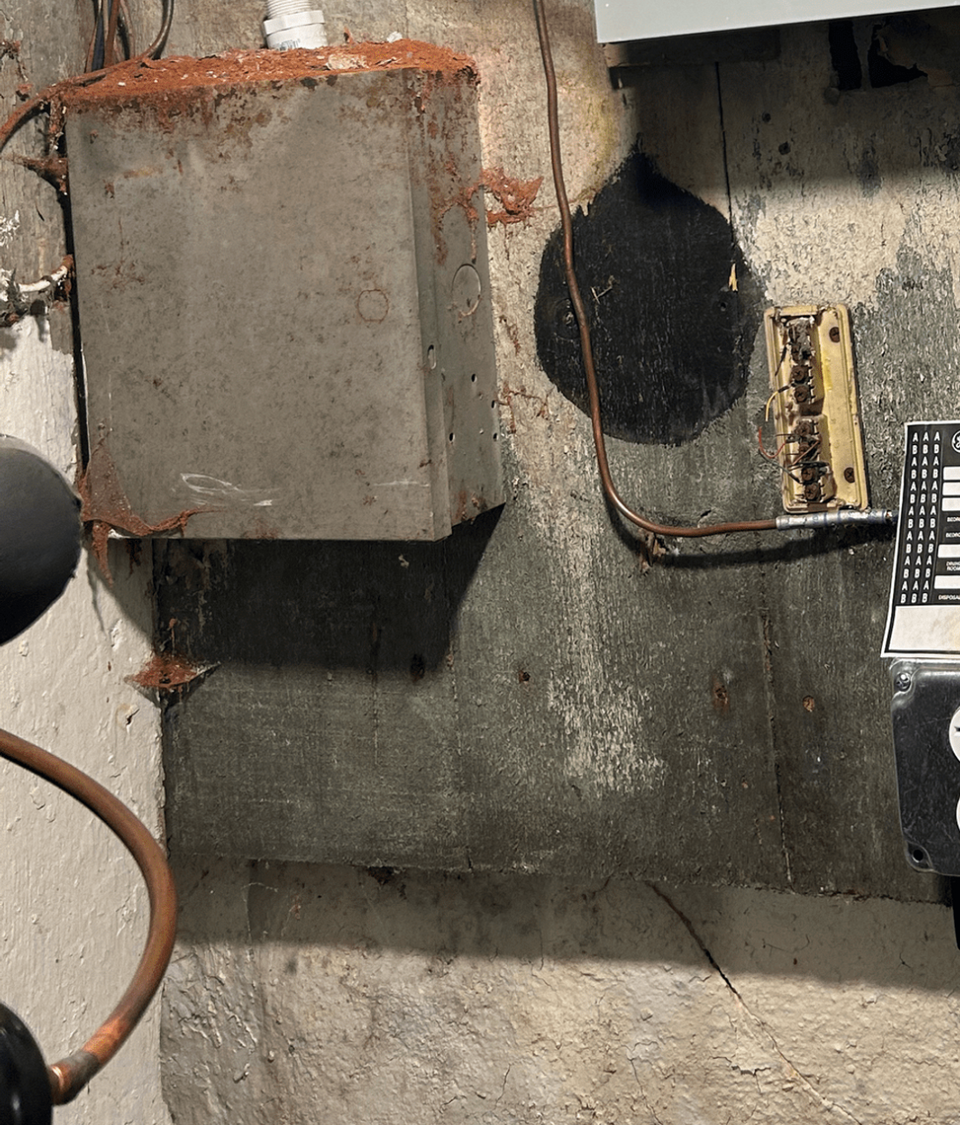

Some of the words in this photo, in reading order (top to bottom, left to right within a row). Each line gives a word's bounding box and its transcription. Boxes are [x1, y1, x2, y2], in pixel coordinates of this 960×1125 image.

[912, 432, 918, 442] A
[922, 432, 930, 442] A
[934, 432, 940, 440] A
[912, 444, 918, 454] B
[922, 444, 928, 454] B
[934, 444, 940, 454] B
[912, 456, 918, 466] A
[922, 456, 928, 466] A
[932, 456, 940, 466] A
[910, 470, 916, 480] B
[922, 468, 928, 478] B
[932, 468, 938, 478] B
[910, 482, 916, 492] A
[920, 480, 926, 490] A
[932, 480, 938, 490] A
[910, 494, 916, 504] B
[920, 494, 926, 504] B
[932, 494, 938, 504] B
[908, 506, 914, 516] A
[918, 506, 926, 516] A
[930, 506, 936, 516] A
[908, 518, 914, 528] B
[918, 518, 924, 528] B
[930, 518, 936, 528] B
[906, 530, 912, 540] A
[918, 530, 924, 540] A
[928, 530, 936, 540] A
[906, 544, 912, 554] B
[916, 544, 922, 554] B
[928, 544, 934, 554] B
[904, 556, 910, 566] A
[916, 556, 922, 566] A
[926, 556, 932, 566] A
[904, 568, 910, 578] B
[914, 568, 920, 578] B
[924, 568, 930, 578] B
[902, 580, 908, 590] A
[912, 580, 918, 590] A
[922, 580, 930, 590] A
[900, 594, 906, 604] B
[910, 592, 918, 604] B
[922, 592, 928, 604] B
